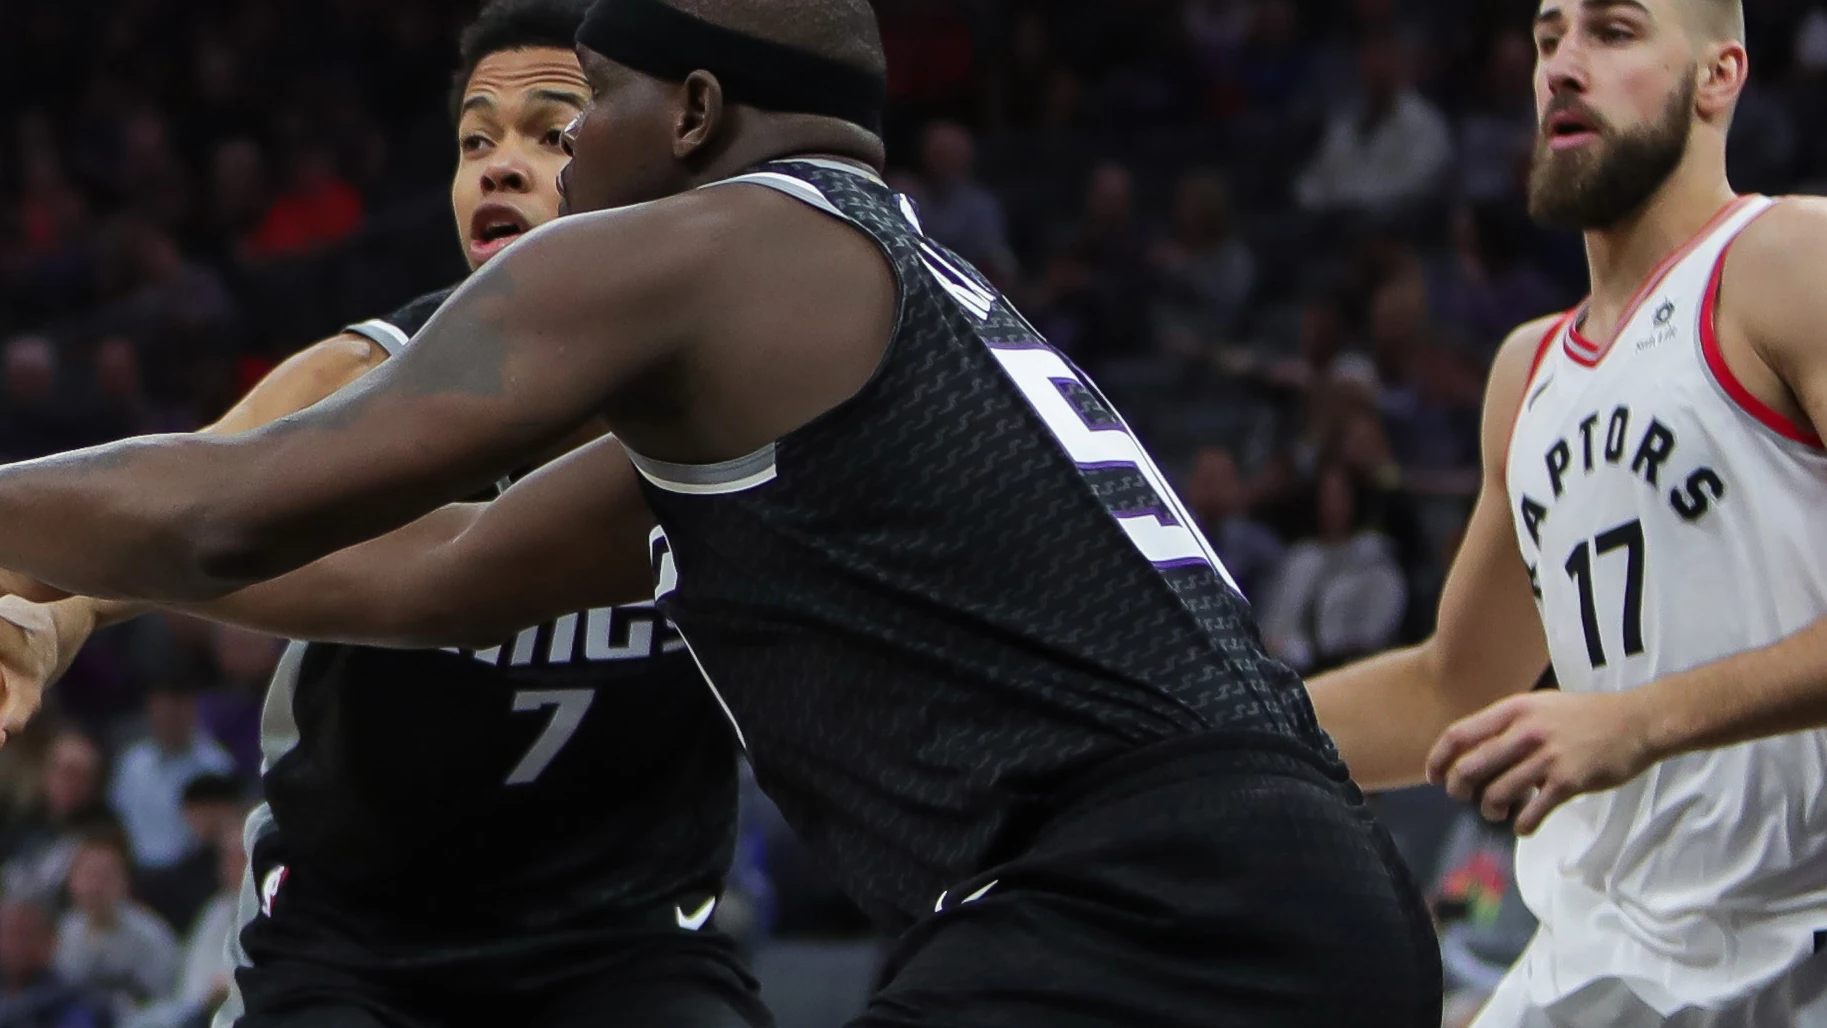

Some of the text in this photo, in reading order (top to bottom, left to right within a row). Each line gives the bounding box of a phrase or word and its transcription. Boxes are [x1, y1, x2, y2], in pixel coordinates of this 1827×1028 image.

[988, 345, 1252, 604] 5
[1521, 405, 1725, 602] APTORS
[1564, 517, 1646, 670] 17
[503, 687, 596, 787] 7
